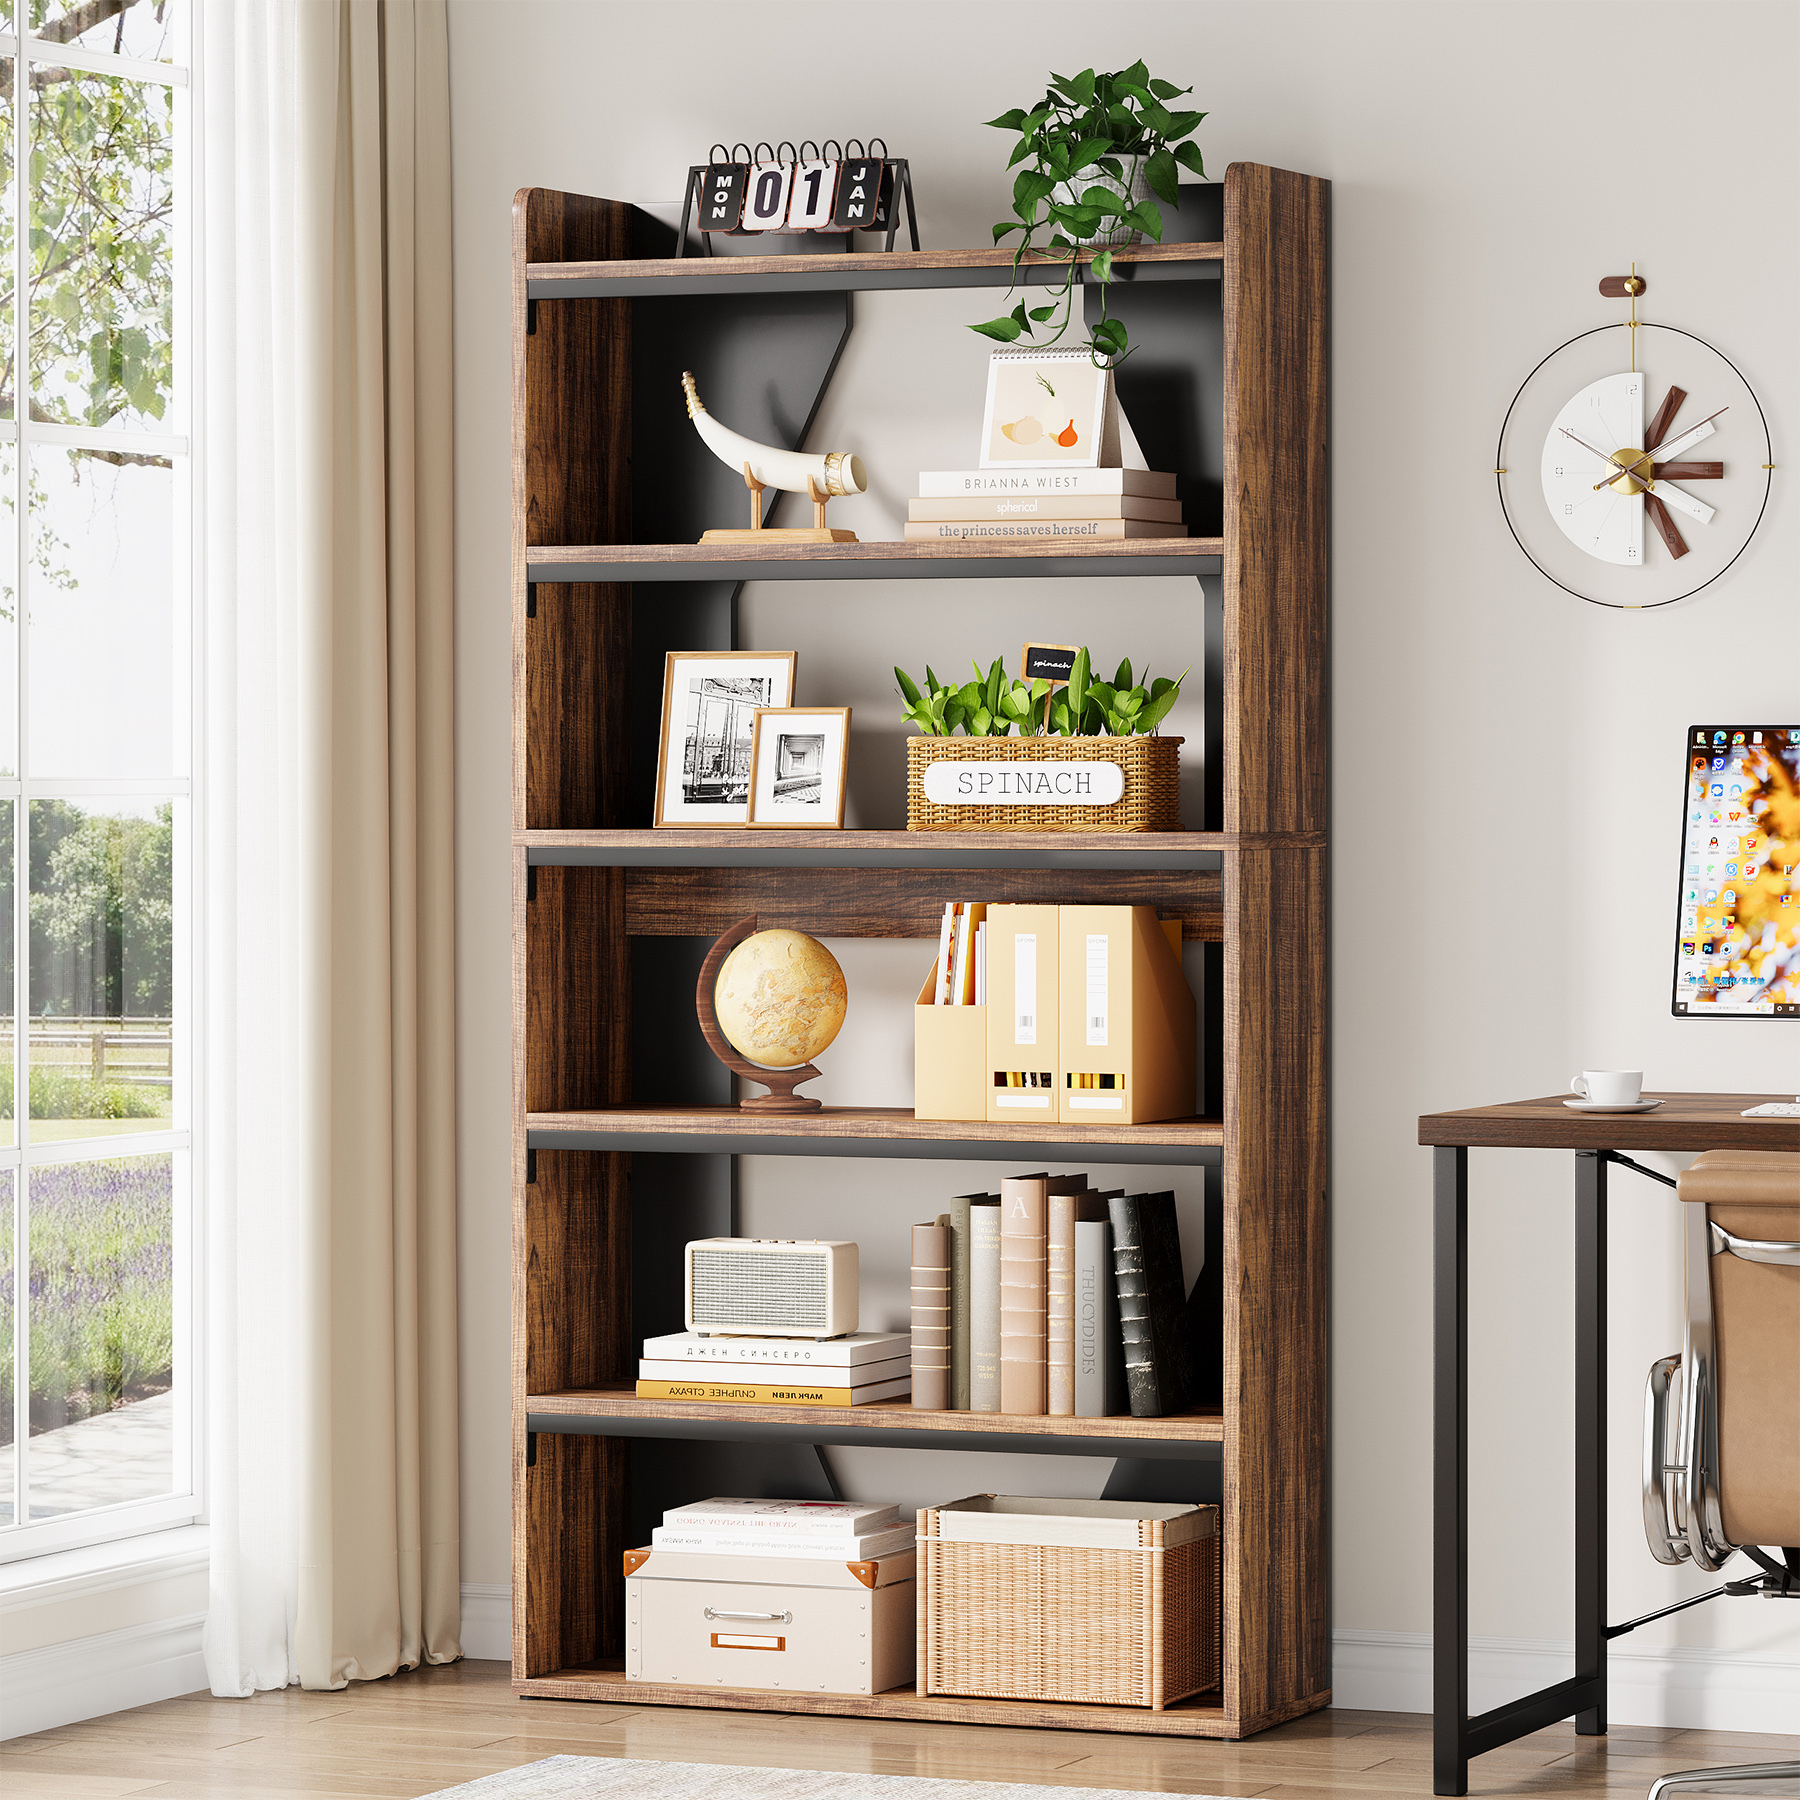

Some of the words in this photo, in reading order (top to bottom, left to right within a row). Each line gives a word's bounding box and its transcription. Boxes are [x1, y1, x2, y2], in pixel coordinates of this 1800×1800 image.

[711, 175, 733, 219] MON
[847, 167, 867, 218] JAN
[1625, 384, 1638, 395] 12
[1590, 397, 1600, 407] 11
[1555, 466, 1563, 478] 9
[964, 478, 1030, 490] BRIANNA
[1036, 476, 1079, 489] WIEST
[996, 499, 1038, 516] spherical
[1564, 503, 1573, 515] 8
[939, 525, 960, 537] the
[962, 523, 1015, 540] princess
[1016, 525, 1051, 537] saves
[1052, 523, 1099, 536] herself
[1667, 532, 1676, 545] 5
[1628, 545, 1637, 558] 6
[1033, 659, 1072, 669] spinach
[957, 772, 1092, 794] SPINACH
[1703, 944, 1713, 952] Ps
[1010, 1196, 1030, 1219] A
[1082, 1266, 1096, 1375] THUCYDIDES
[687, 1347, 728, 1356] ДЖЕН
[740, 1349, 811, 1360] СИНСЕРО
